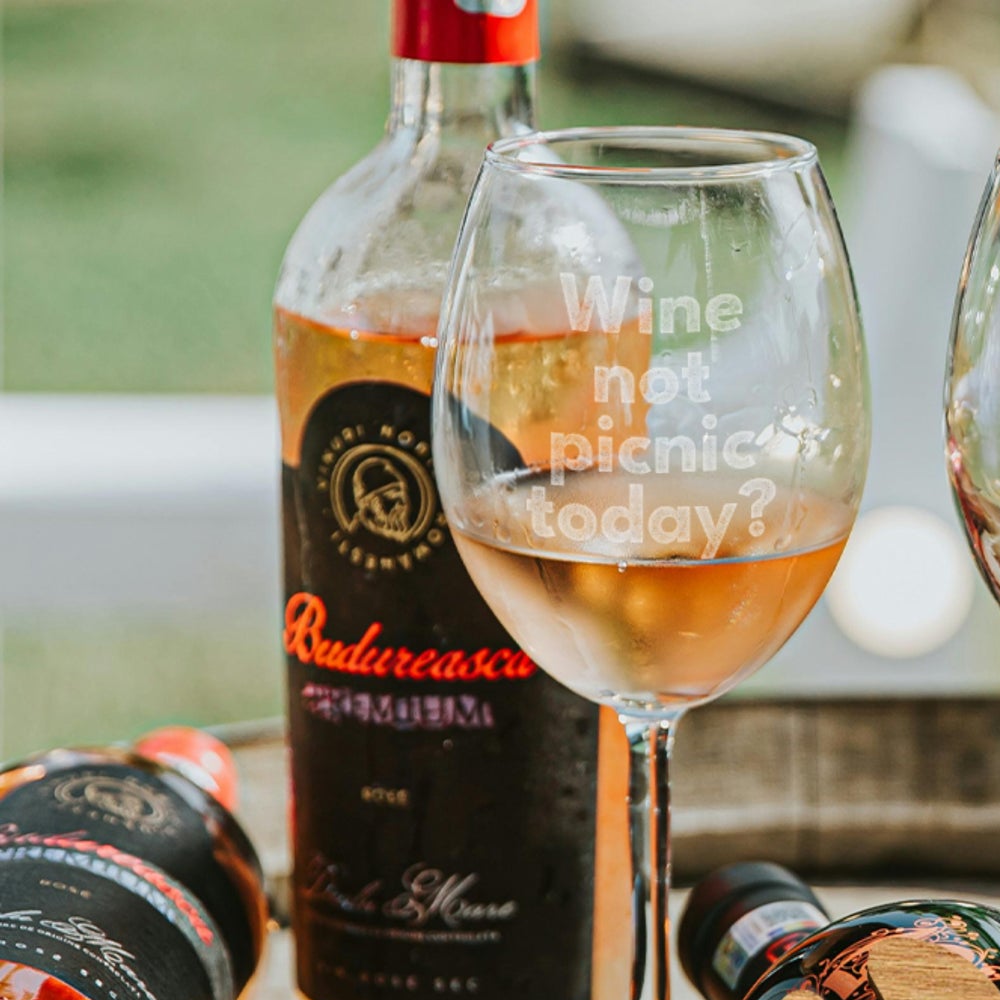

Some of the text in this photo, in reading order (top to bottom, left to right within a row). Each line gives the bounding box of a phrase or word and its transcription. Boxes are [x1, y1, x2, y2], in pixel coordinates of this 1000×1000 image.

[560, 272, 743, 334] Wine
[593, 351, 711, 404] not
[551, 414, 757, 486] picnic
[526, 477, 777, 560] today?
[283, 592, 538, 681] Budureasca
